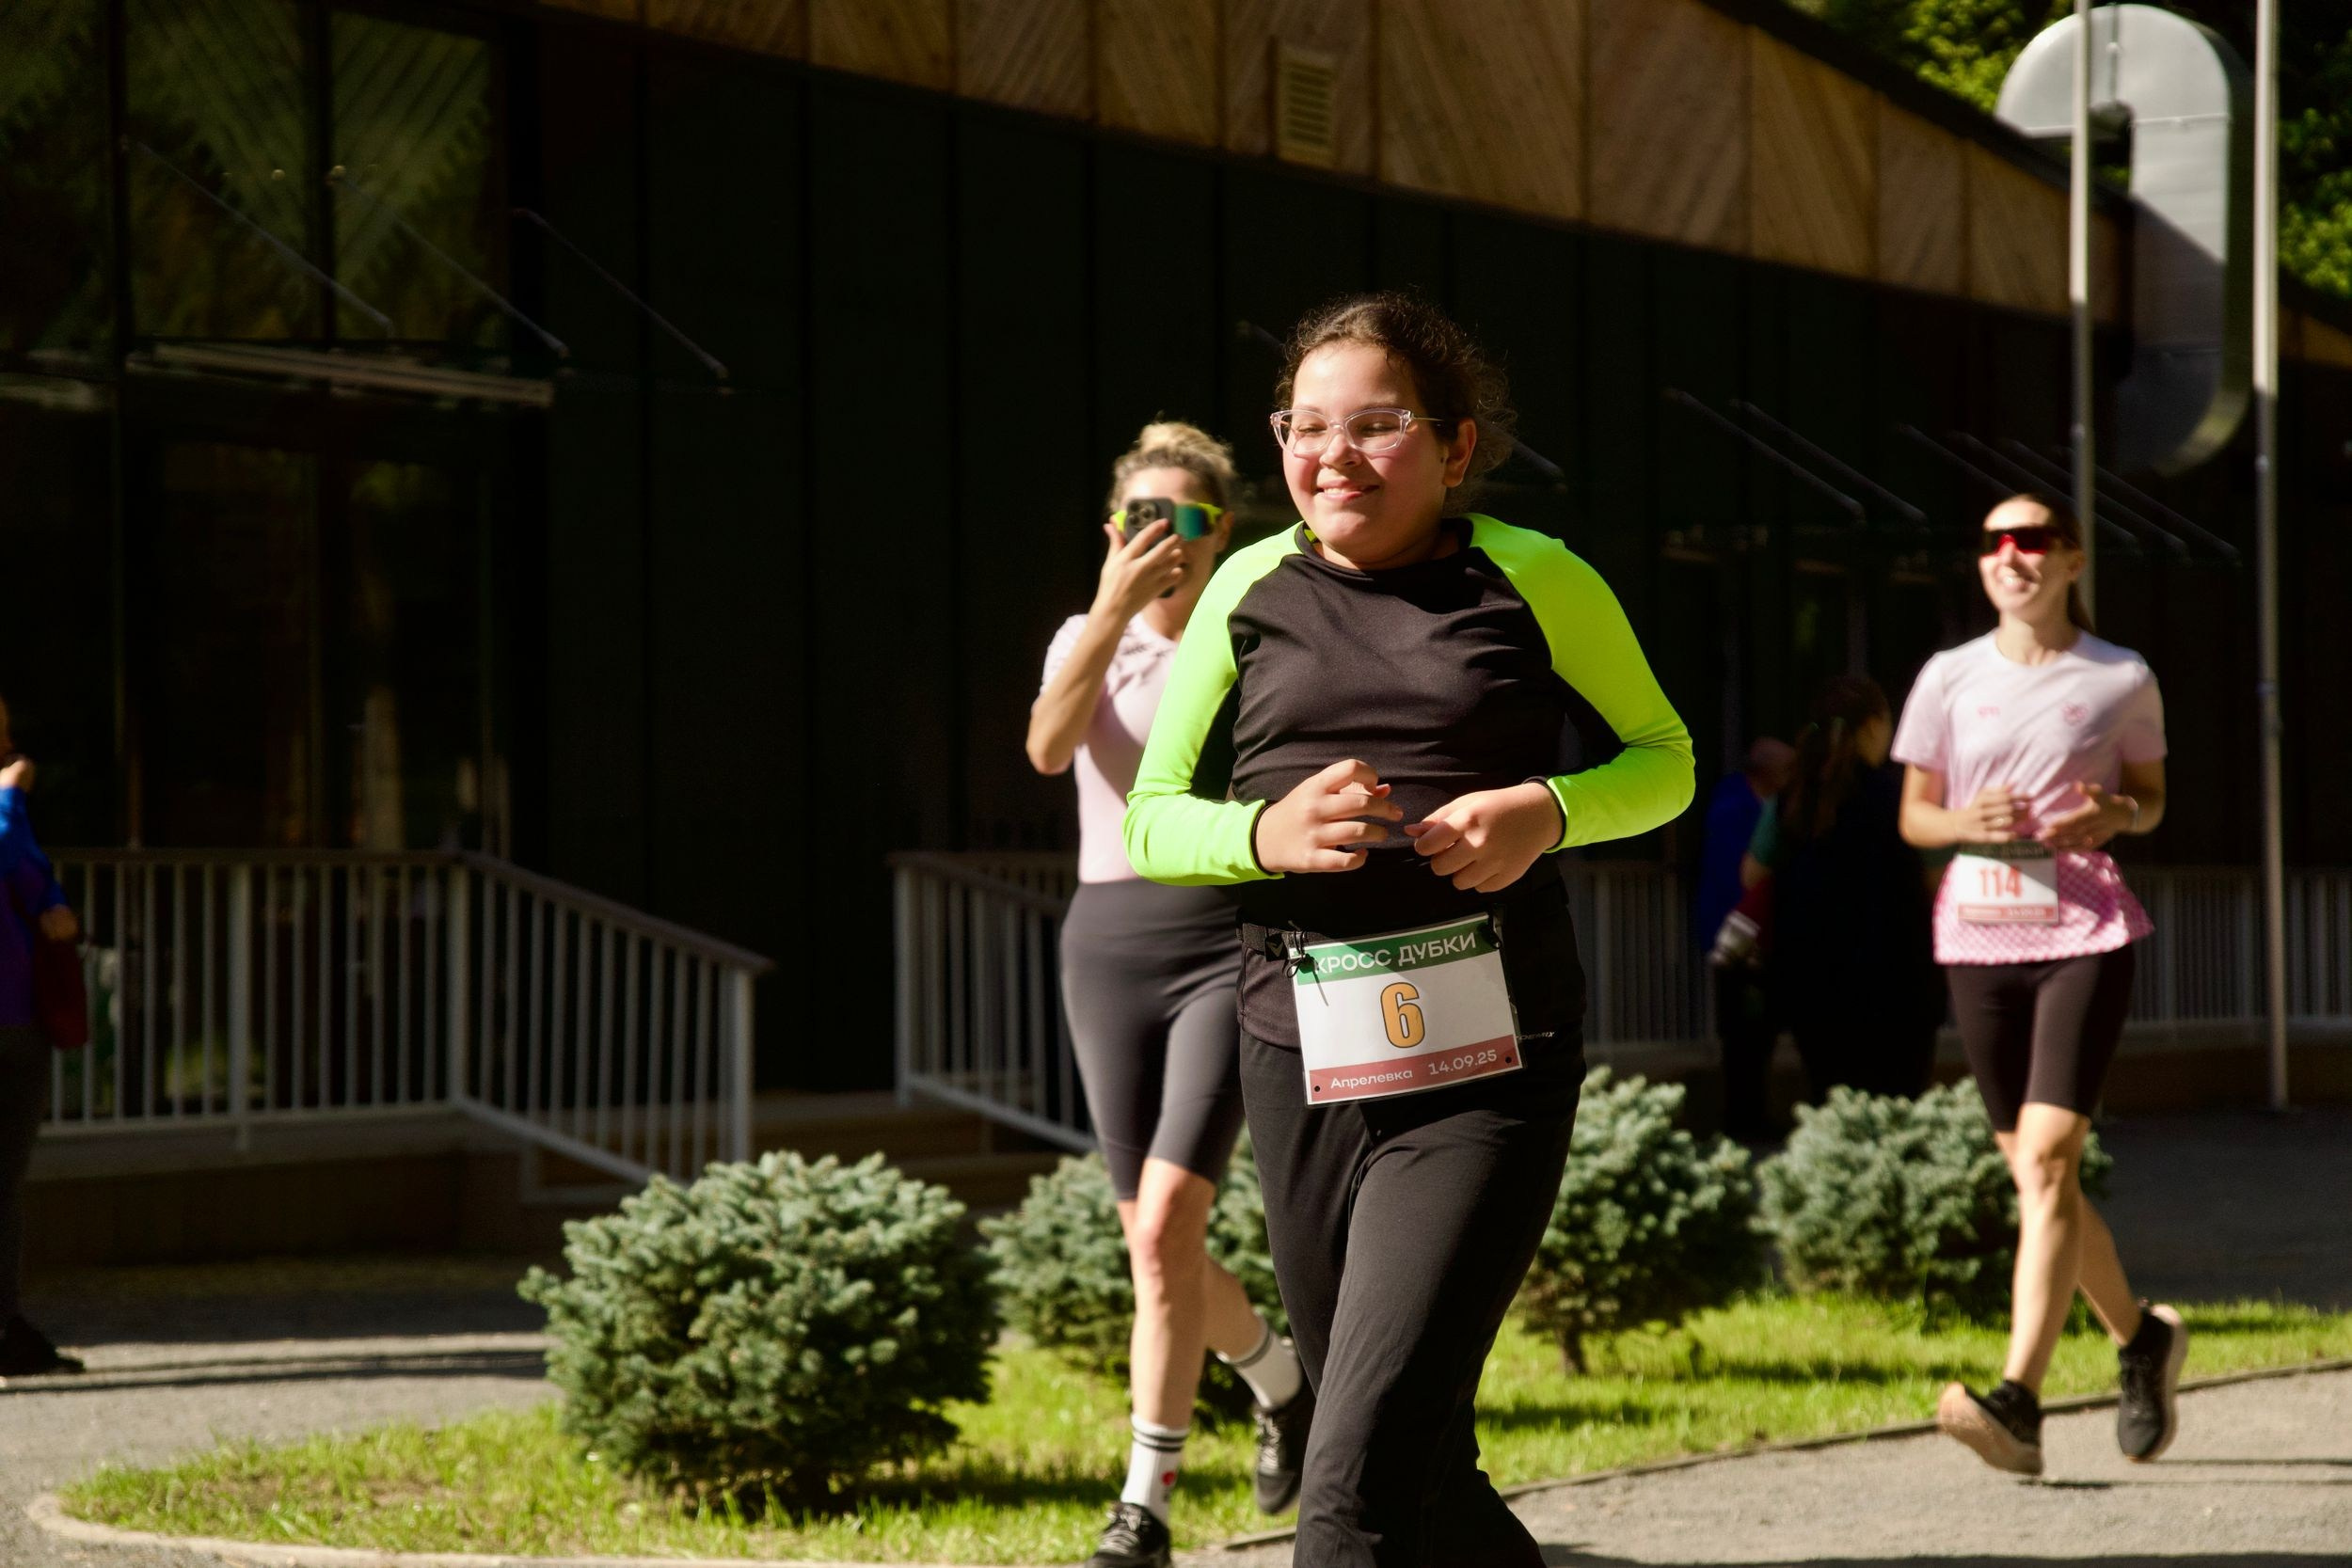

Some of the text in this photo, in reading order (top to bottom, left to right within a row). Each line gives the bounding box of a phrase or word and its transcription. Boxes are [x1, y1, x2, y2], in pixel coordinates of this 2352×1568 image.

[1979, 865, 2023, 898] 114
[1313, 932, 1476, 974] КРОСС ДУБКИ
[1380, 981, 1426, 1049] 6
[1330, 1049, 1498, 1089] Апрелевка 14.09.25
